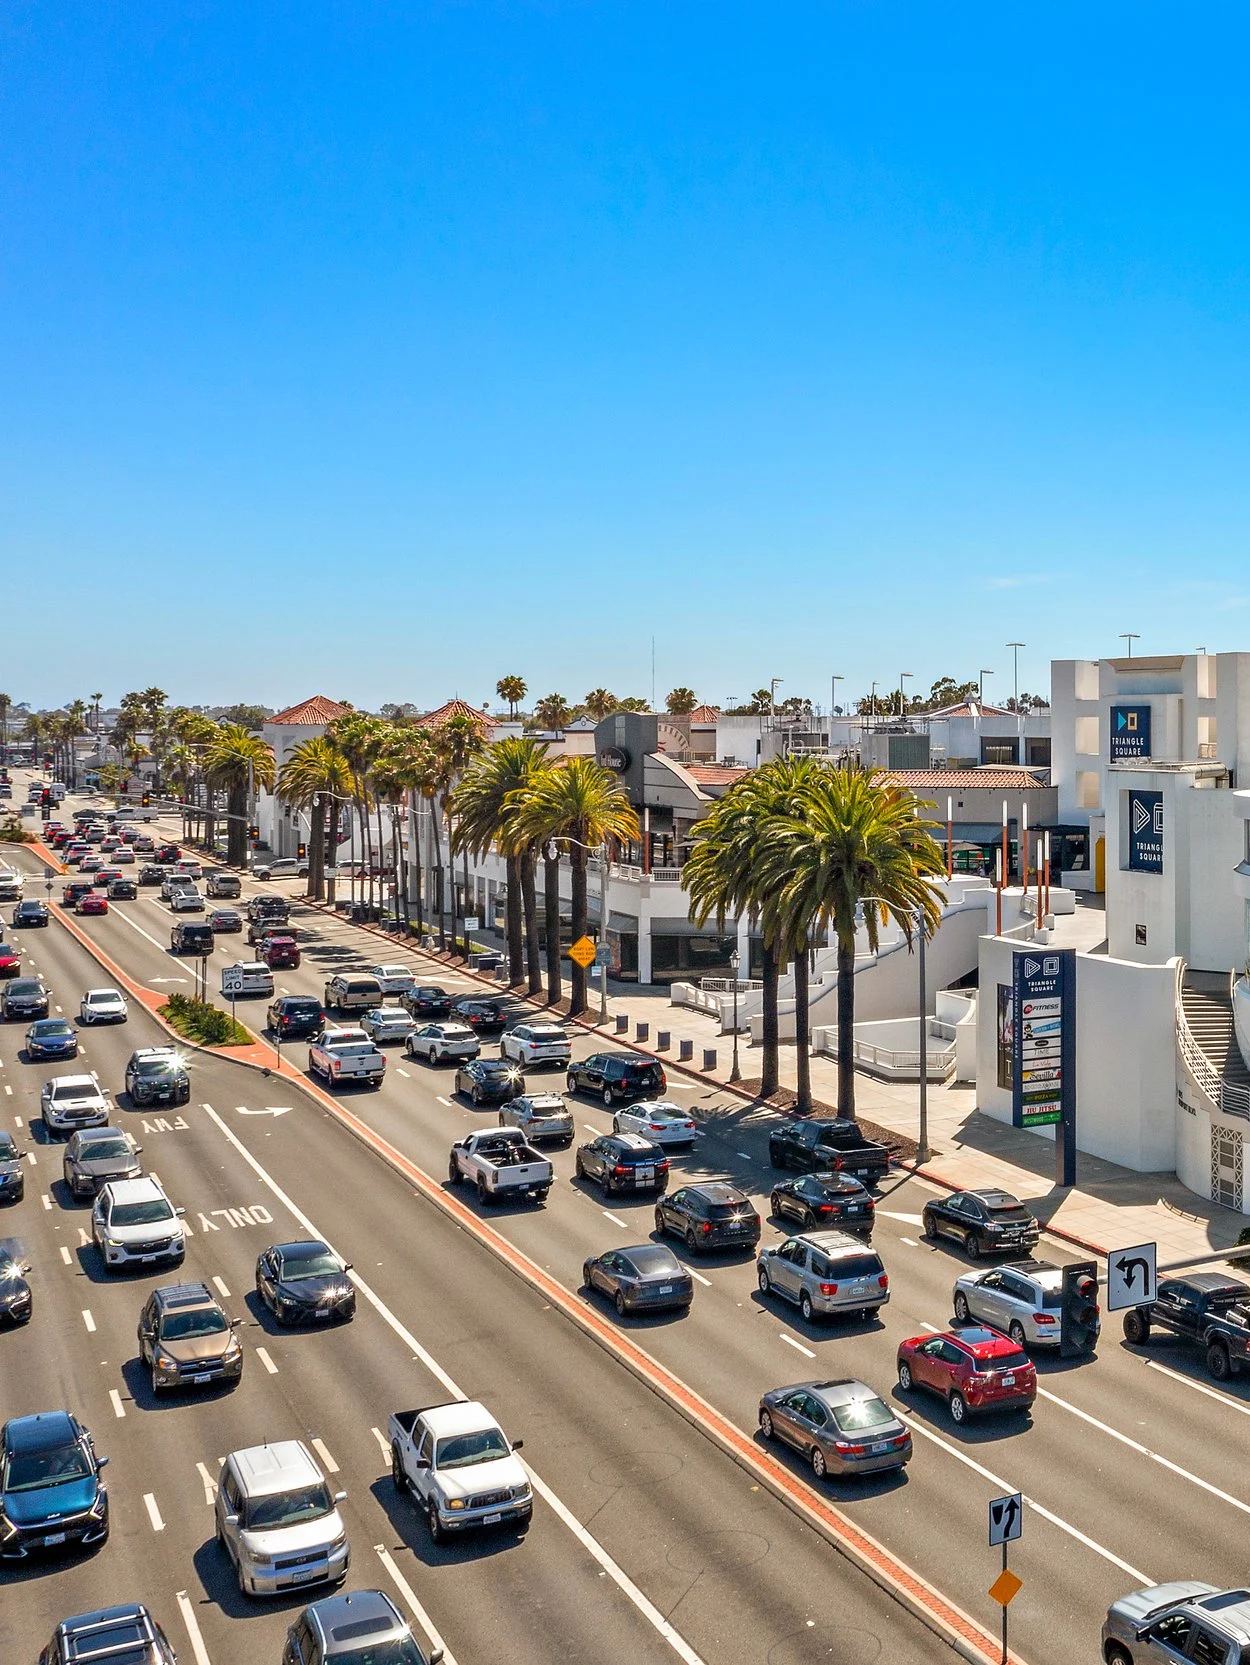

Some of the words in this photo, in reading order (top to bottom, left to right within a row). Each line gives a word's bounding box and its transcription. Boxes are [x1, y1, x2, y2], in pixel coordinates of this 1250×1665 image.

[1112, 737, 1144, 746] TRIANGLE
[1115, 747, 1141, 756] SQUARE
[1139, 853, 1163, 862] SQUAR
[225, 981, 242, 990] 40
[1032, 1003, 1059, 1011] FITNESS
[141, 1115, 191, 1134] FWY
[197, 1204, 275, 1233] ONLY
